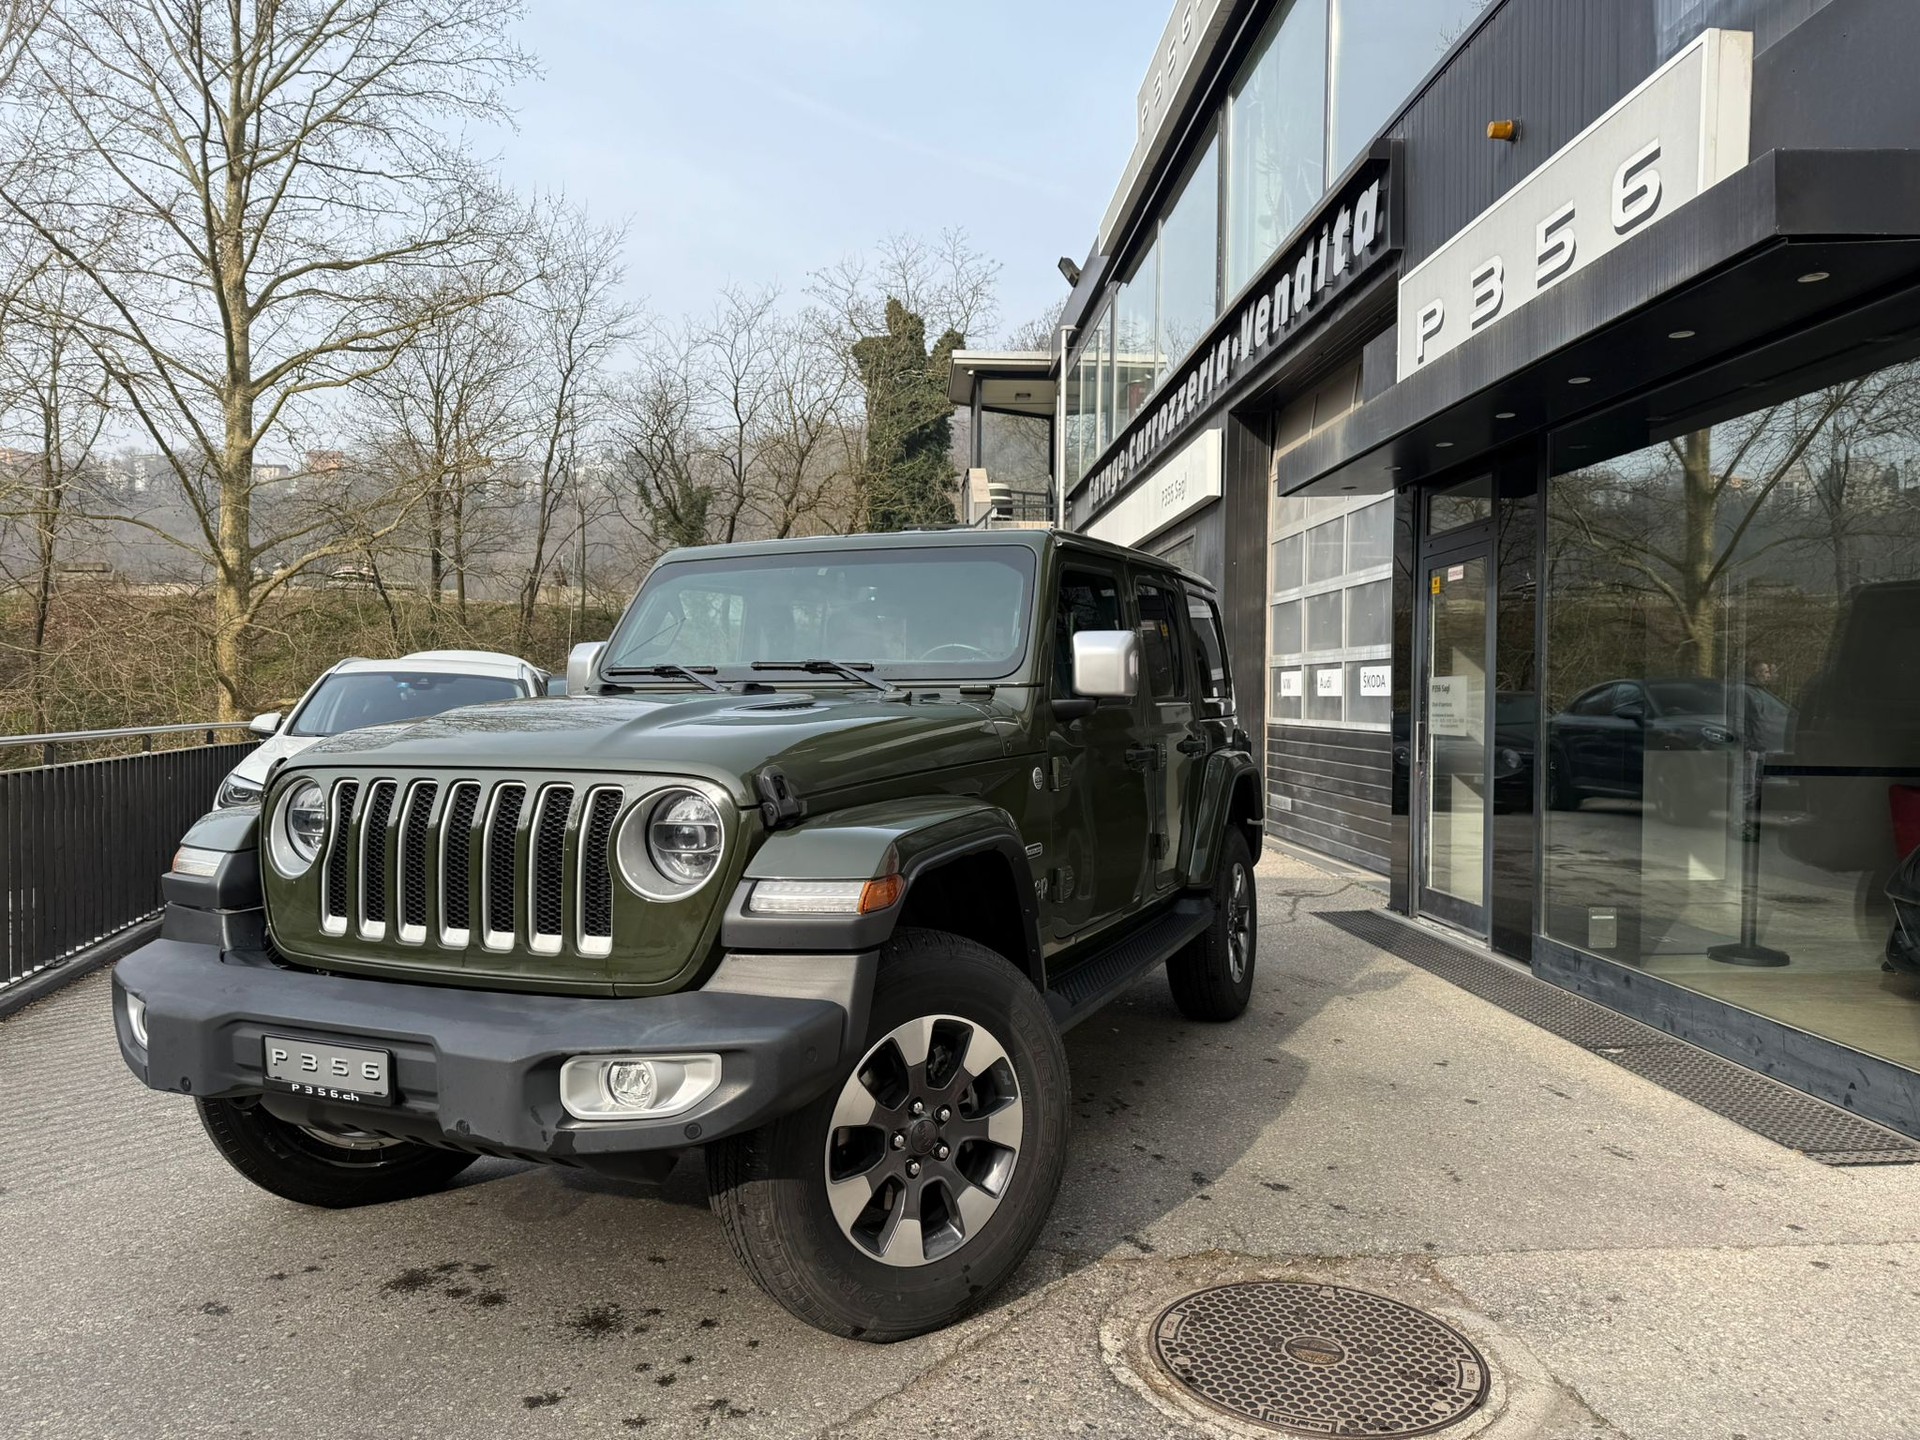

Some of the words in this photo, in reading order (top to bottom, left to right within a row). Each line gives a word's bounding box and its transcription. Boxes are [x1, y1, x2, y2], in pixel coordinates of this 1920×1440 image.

[1320, 676, 1332, 689] Audi
[1362, 672, 1386, 689] ŠKODA
[291, 1083, 360, 1102] P356.ch
